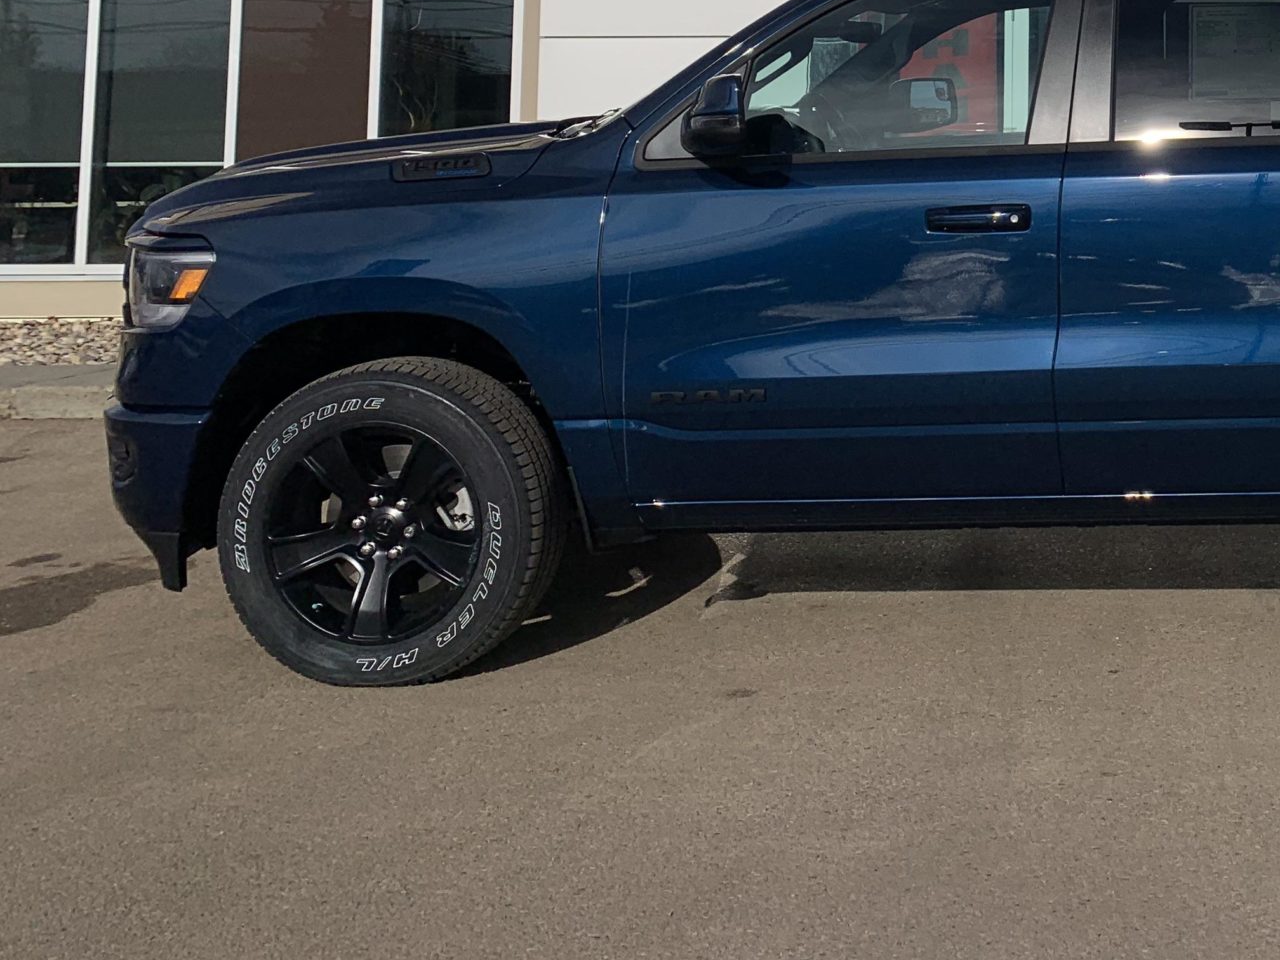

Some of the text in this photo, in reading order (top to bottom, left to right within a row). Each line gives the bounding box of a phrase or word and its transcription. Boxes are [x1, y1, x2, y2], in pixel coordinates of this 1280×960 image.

[650, 389, 767, 404] RAM
[234, 397, 385, 573] BRIDGESTONE
[356, 502, 502, 672] DUELER H/L
